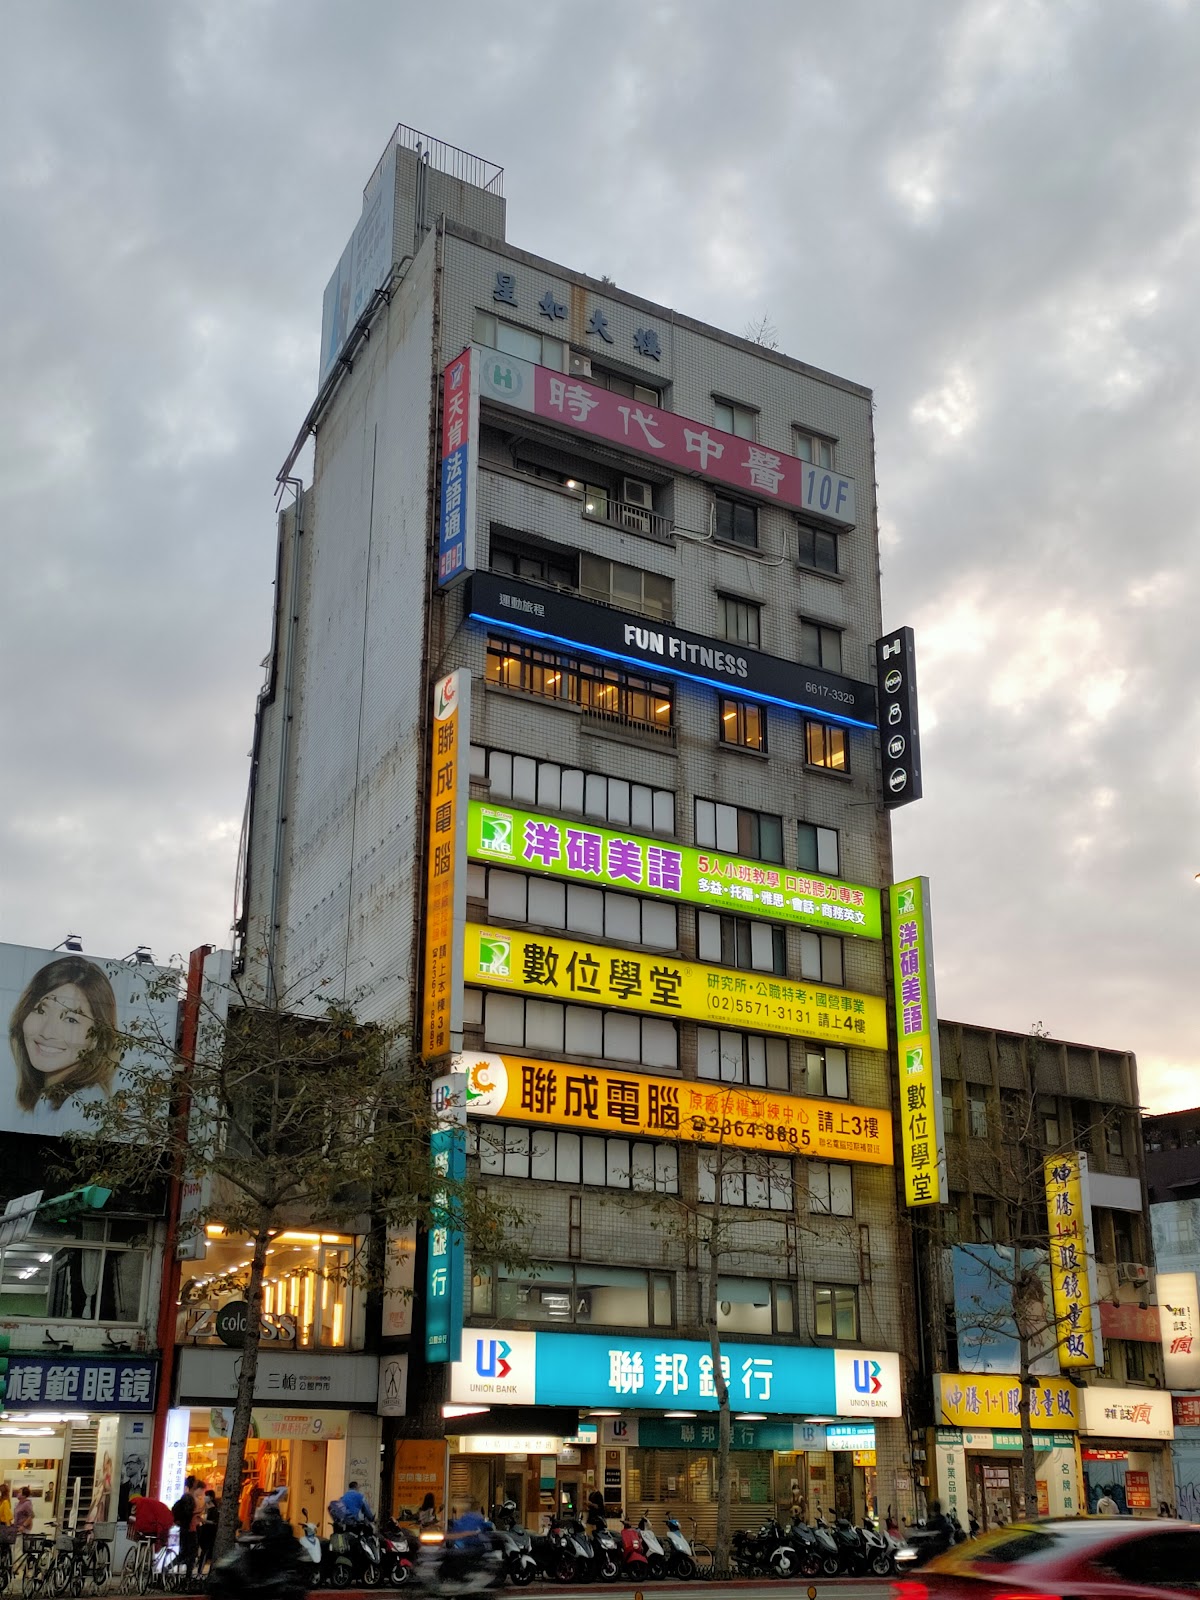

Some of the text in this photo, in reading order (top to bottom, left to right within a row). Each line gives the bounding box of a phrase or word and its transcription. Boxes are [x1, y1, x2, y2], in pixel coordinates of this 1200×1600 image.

[549, 377, 849, 514] 時代中醫 10F
[498, 593, 546, 618] 運動旅程
[624, 623, 749, 679] FUN FITNESS
[805, 681, 856, 705] 6617-3329
[434, 720, 454, 877] 聯成電腦
[483, 839, 511, 853] TKB
[523, 819, 682, 893] 洋碩美語
[698, 855, 780, 888] 5人小班教學
[480, 962, 509, 976] TKB
[522, 943, 682, 1009] 數位學堂
[899, 920, 923, 1035] 洋碩美語
[707, 993, 811, 1024] (02)5571-3131
[817, 1012, 866, 1034] 請上4樓
[521, 1065, 680, 1131] 聯成電腦
[818, 1109, 879, 1139] 請上3樓
[907, 1083, 932, 1201] 數位學堂
[6, 1365, 151, 1403] 模範眼鏡
[470, 1384, 517, 1393] UNION BANK
[608, 1350, 773, 1400] 聯邦銀行
[1104, 1403, 1153, 1424] 雜誌瘋
